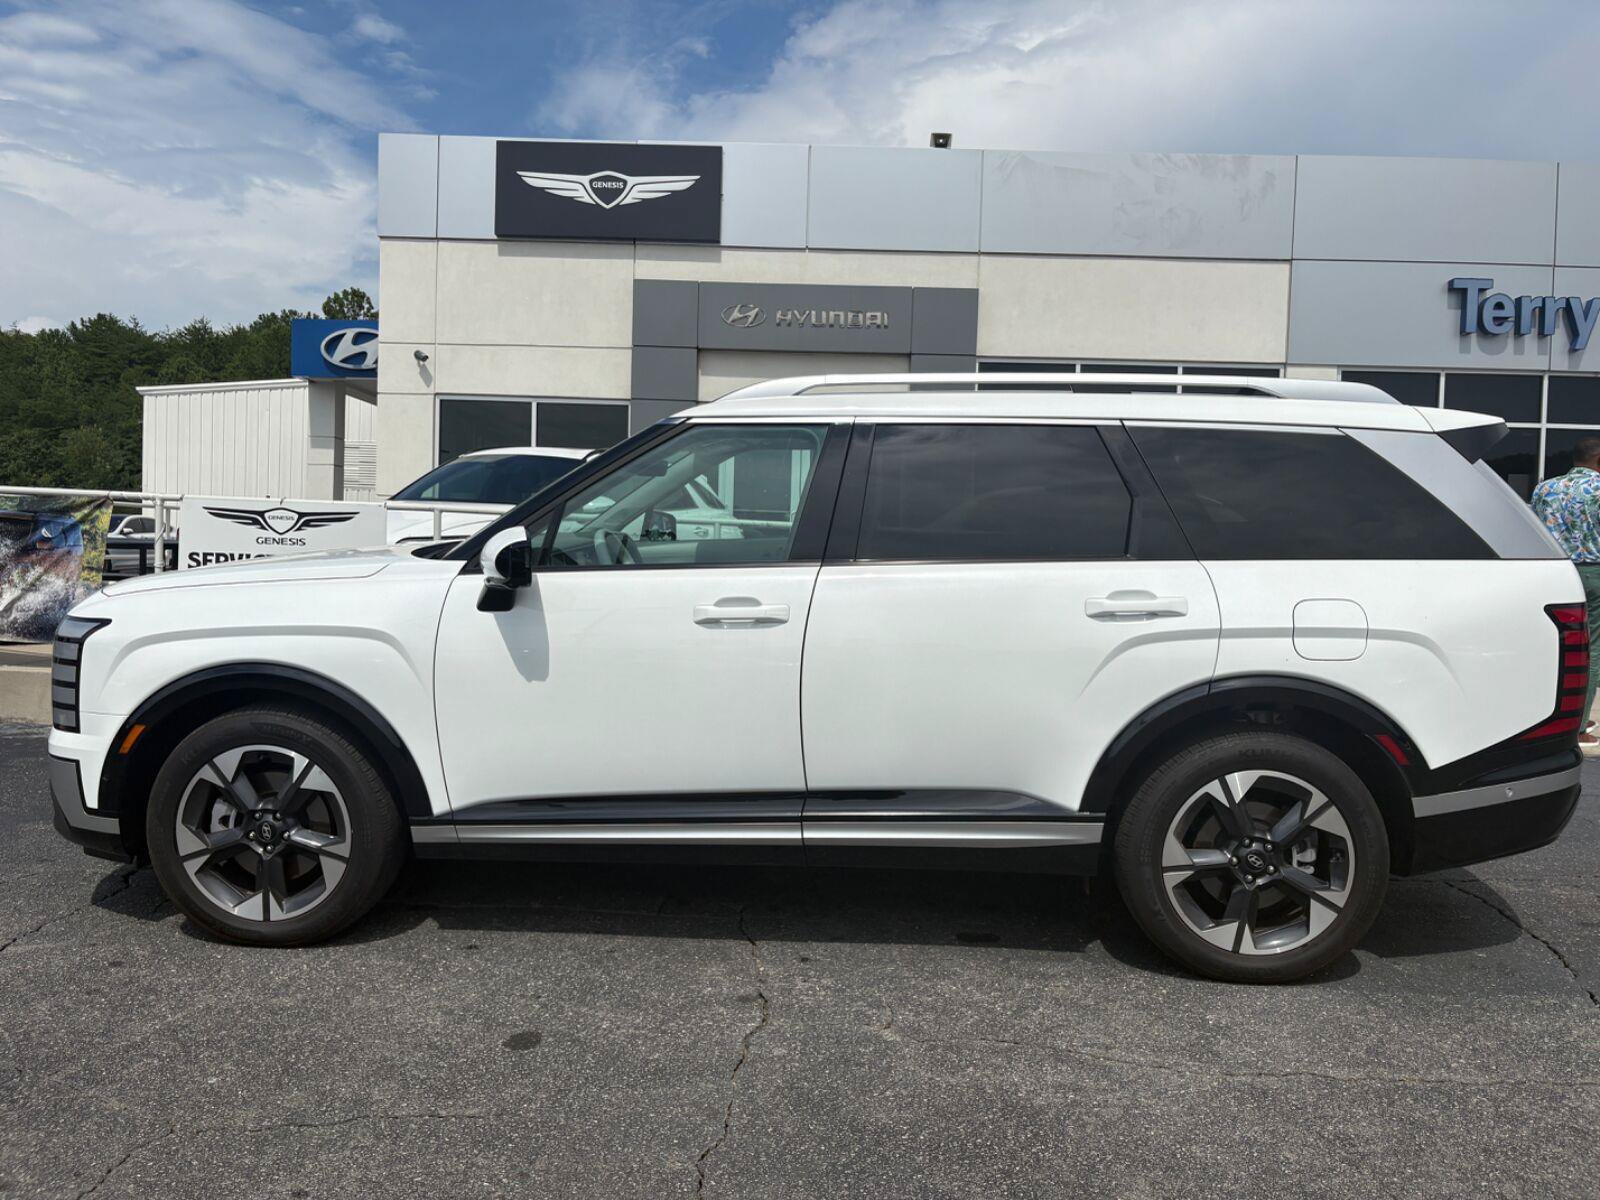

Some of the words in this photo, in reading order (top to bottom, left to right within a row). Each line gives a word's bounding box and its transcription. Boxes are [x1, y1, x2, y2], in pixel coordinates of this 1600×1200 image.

[592, 180, 625, 189] GENESIS
[776, 310, 889, 328] HYUNDAI
[1448, 277, 1600, 351] Terry
[267, 514, 295, 522] GENESIS
[255, 536, 307, 547] GENESIS
[187, 551, 275, 569] SERV
